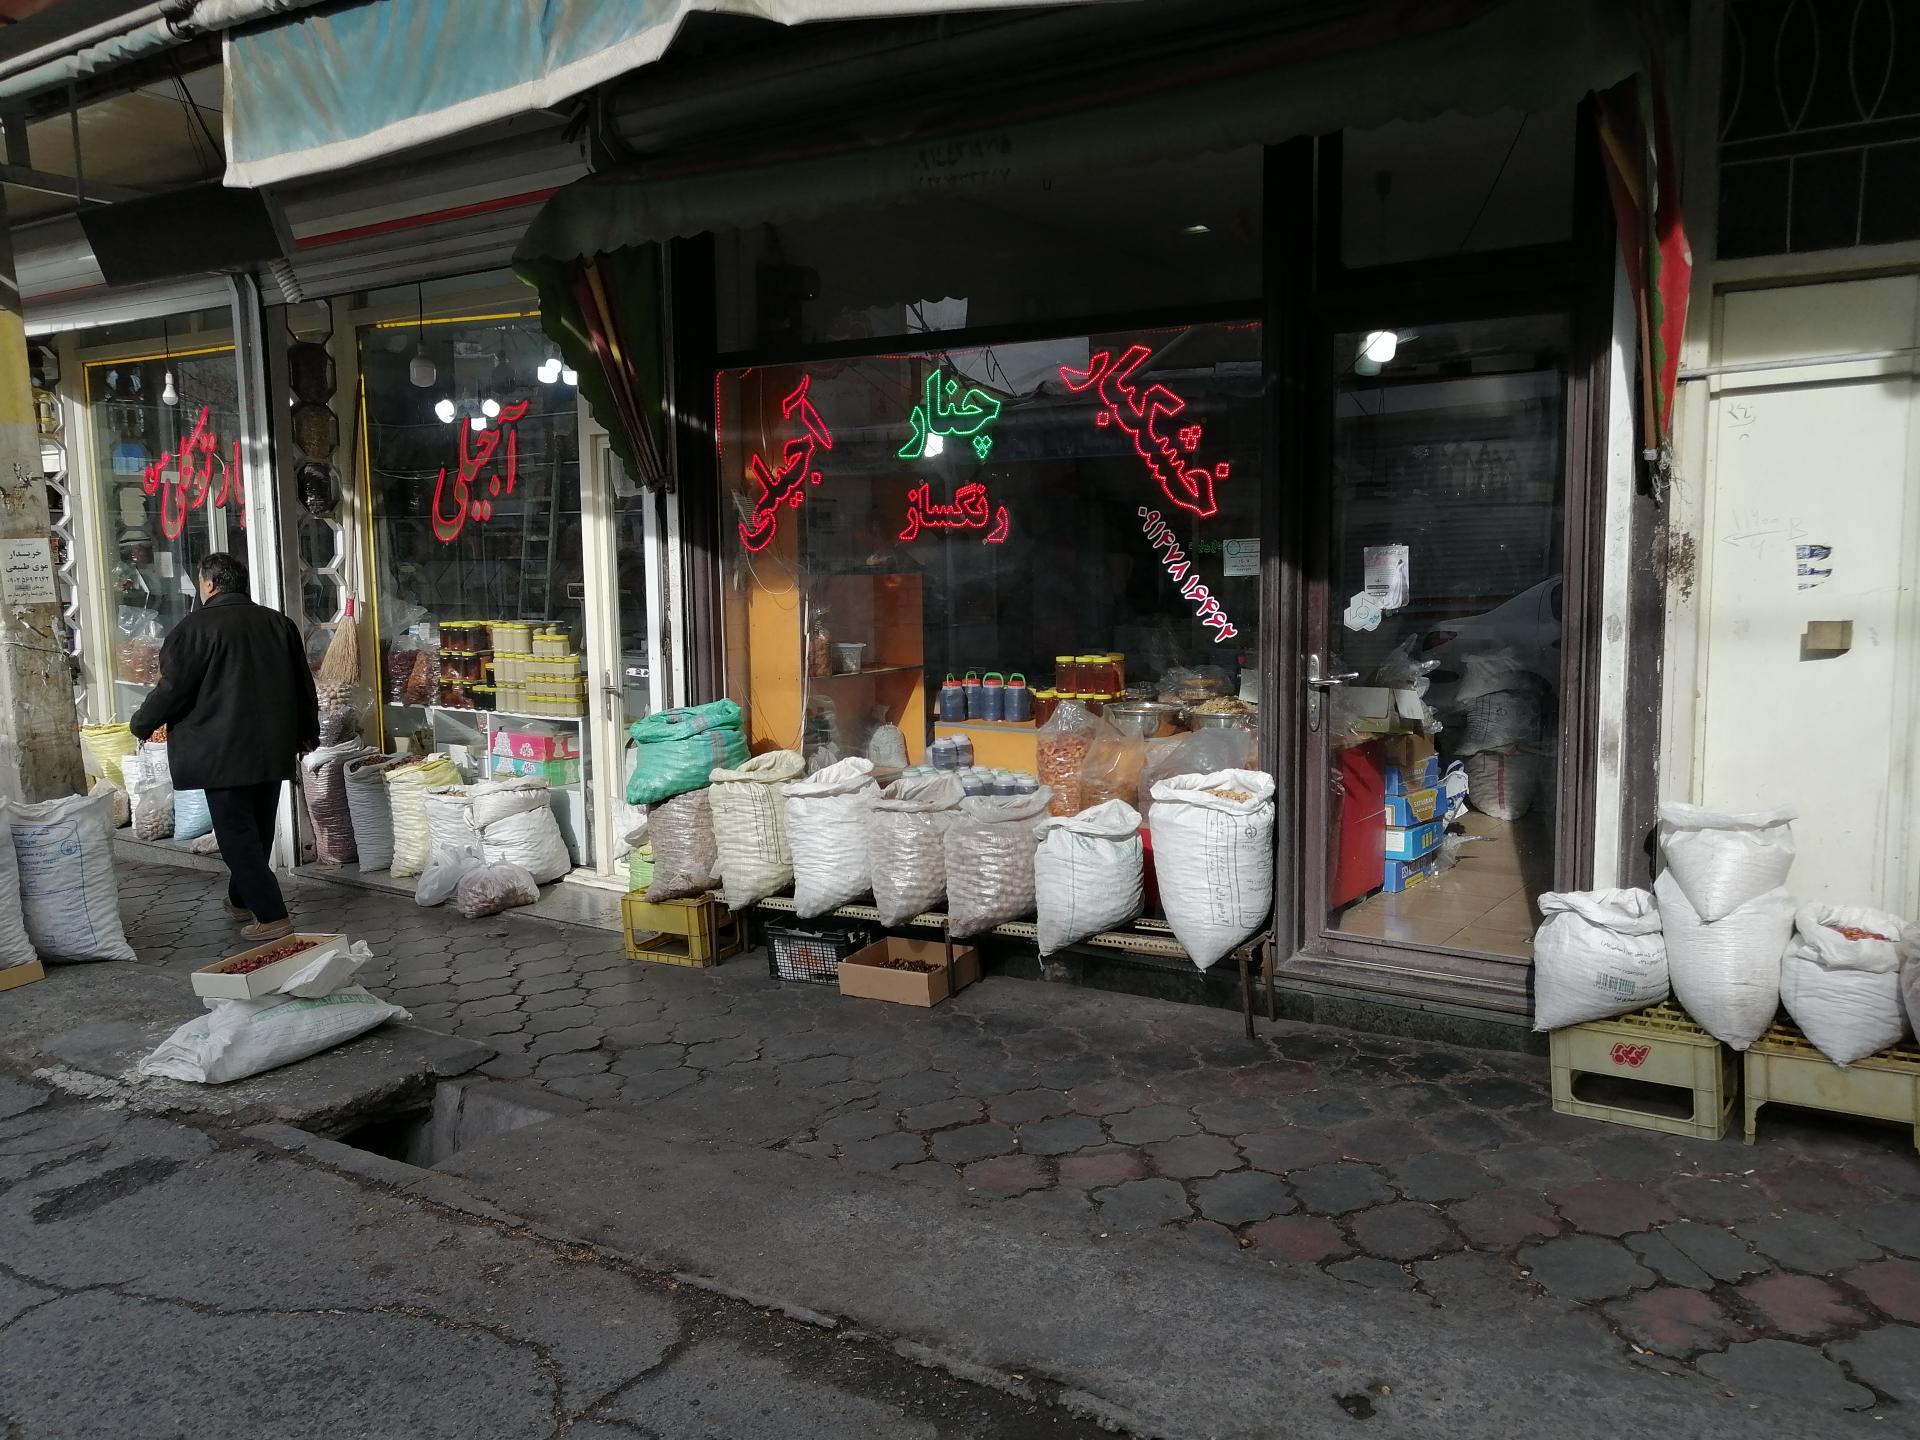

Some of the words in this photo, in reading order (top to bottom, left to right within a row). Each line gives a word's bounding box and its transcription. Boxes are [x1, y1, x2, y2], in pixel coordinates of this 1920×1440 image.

[432, 399, 529, 542] آجیلی
[737, 373, 833, 552] آجیلی
[898, 369, 1001, 459] چنار
[1058, 344, 1230, 517] خشکبار
[898, 482, 1009, 543] رنگساز
[1138, 506, 1238, 643] ۰۹۱۴۷۸۱۶۴۶۲
